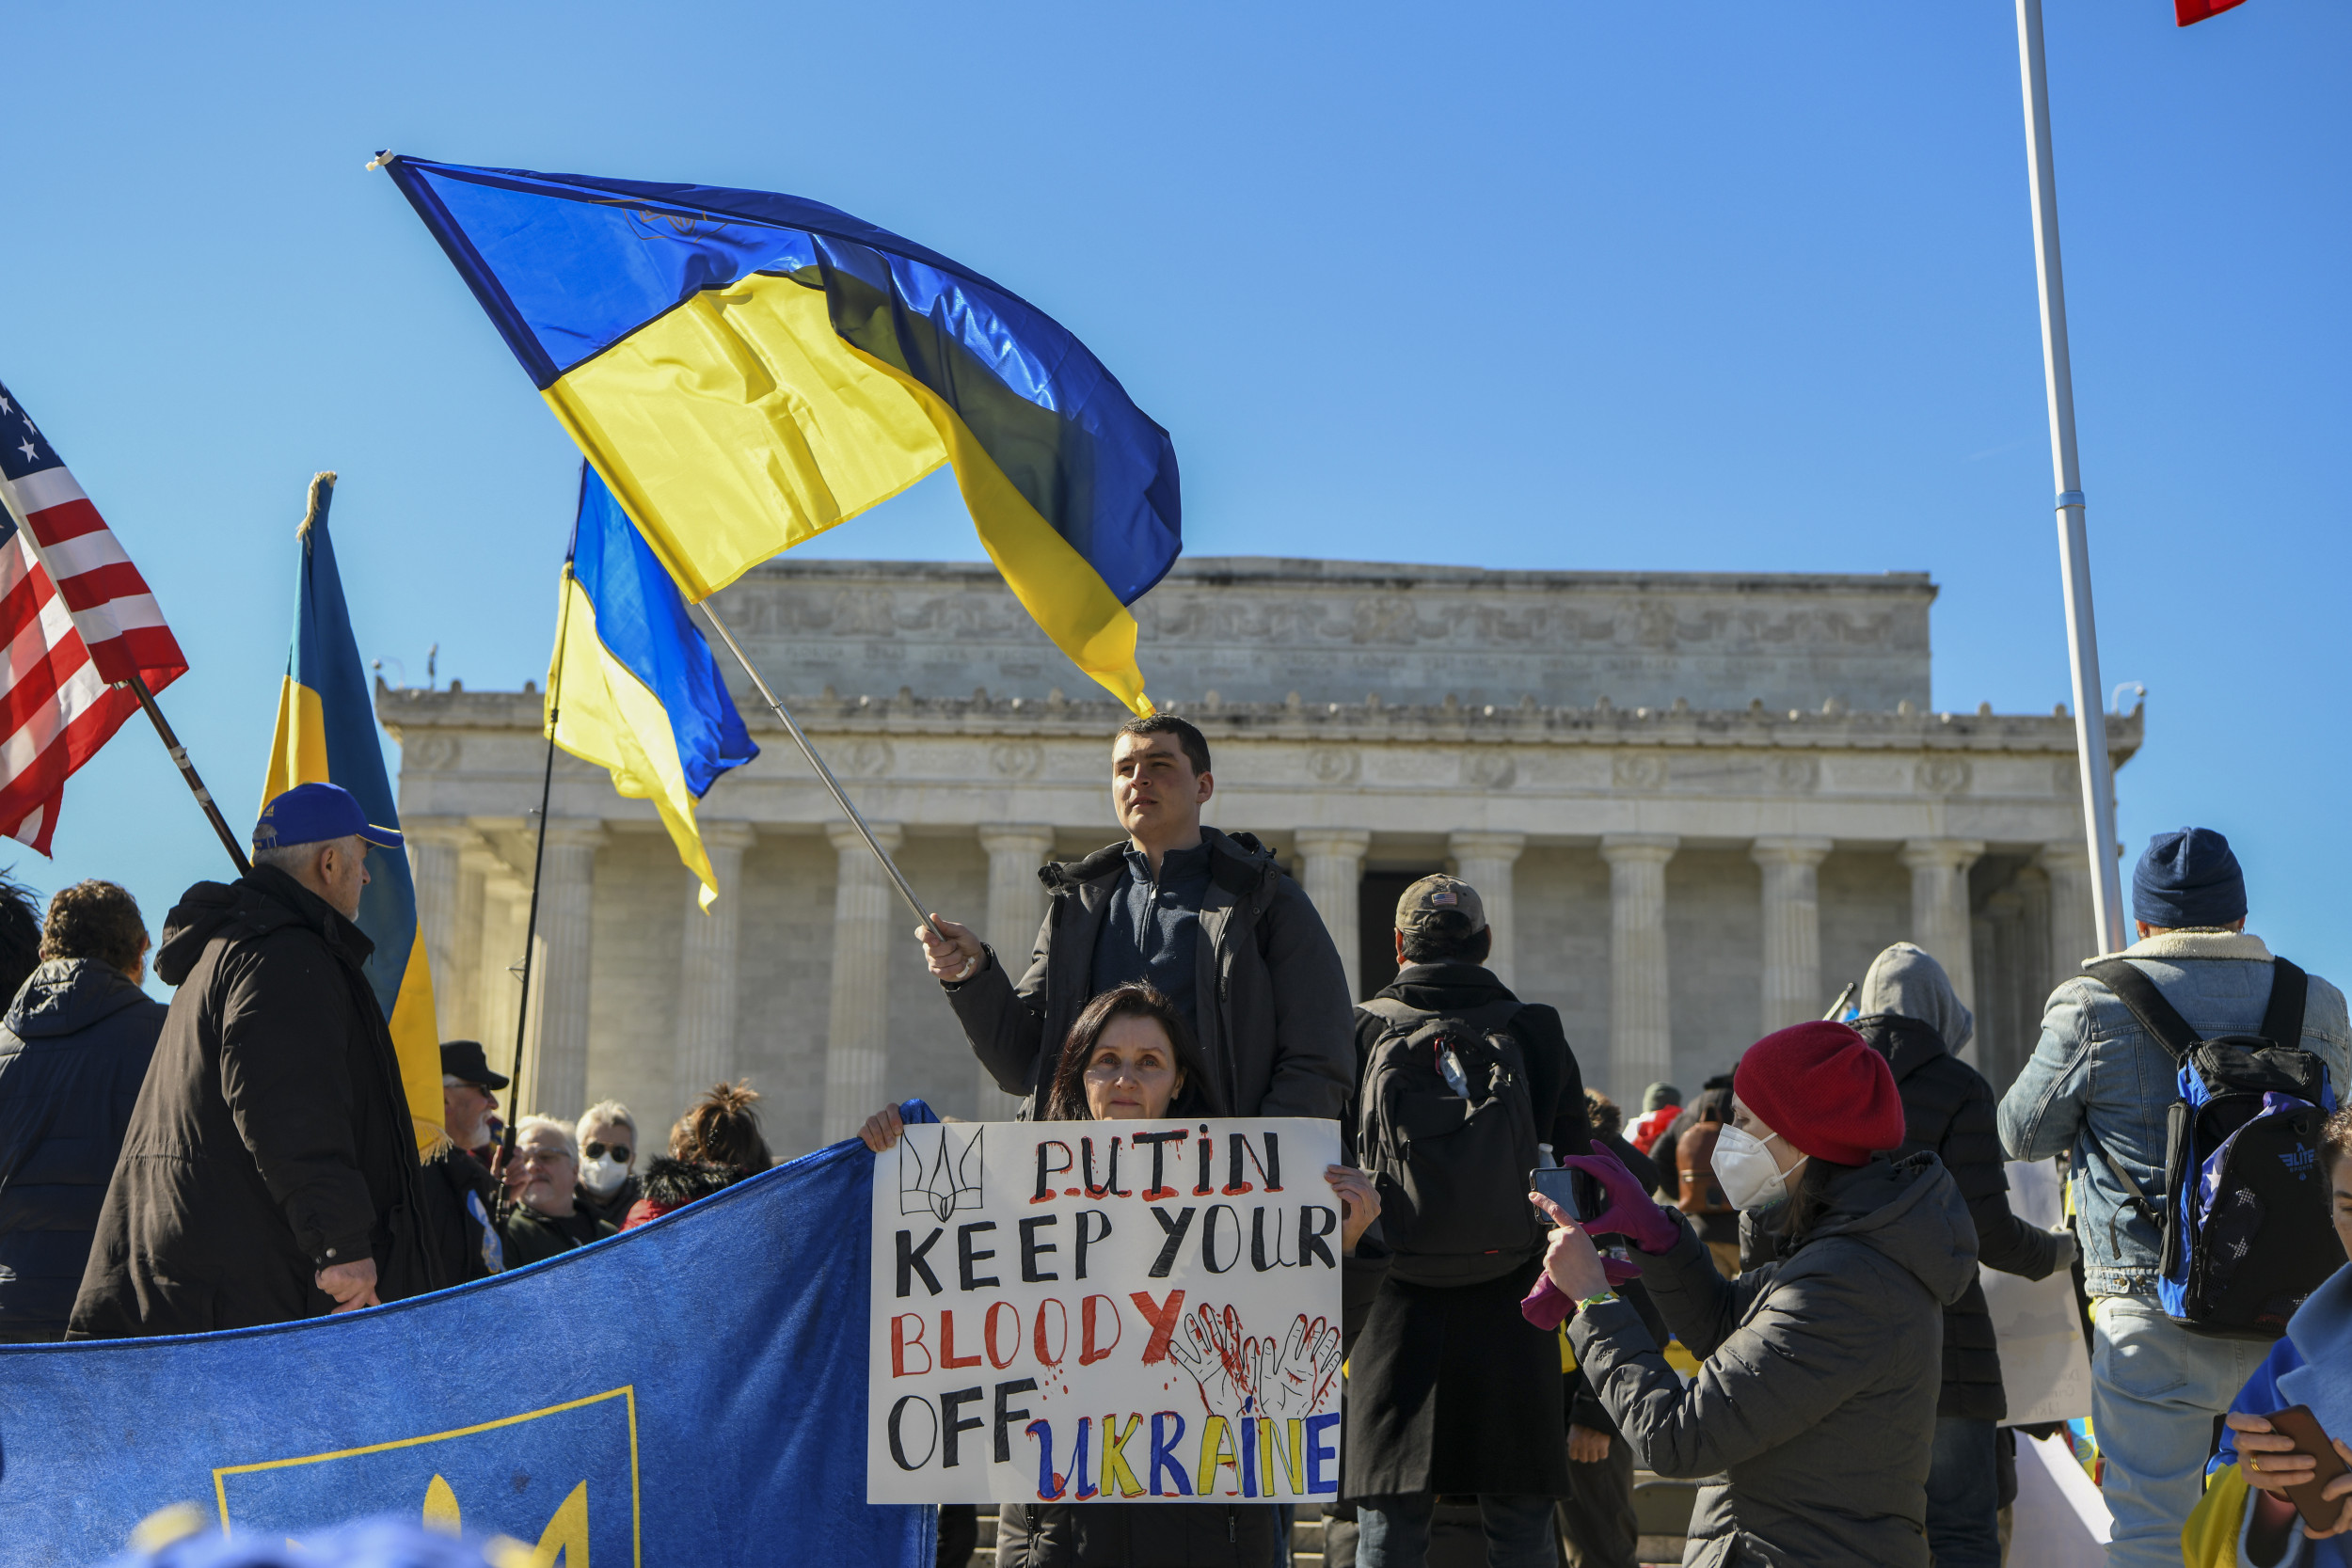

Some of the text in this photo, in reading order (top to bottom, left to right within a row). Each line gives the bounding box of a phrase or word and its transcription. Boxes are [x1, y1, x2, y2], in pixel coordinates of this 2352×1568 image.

[2278, 1148, 2315, 1167] ELITE
[895, 1204, 1337, 1297] KEEP YOUR
[891, 1290, 1186, 1379] BLOODY
[887, 1377, 1039, 1471] OFF
